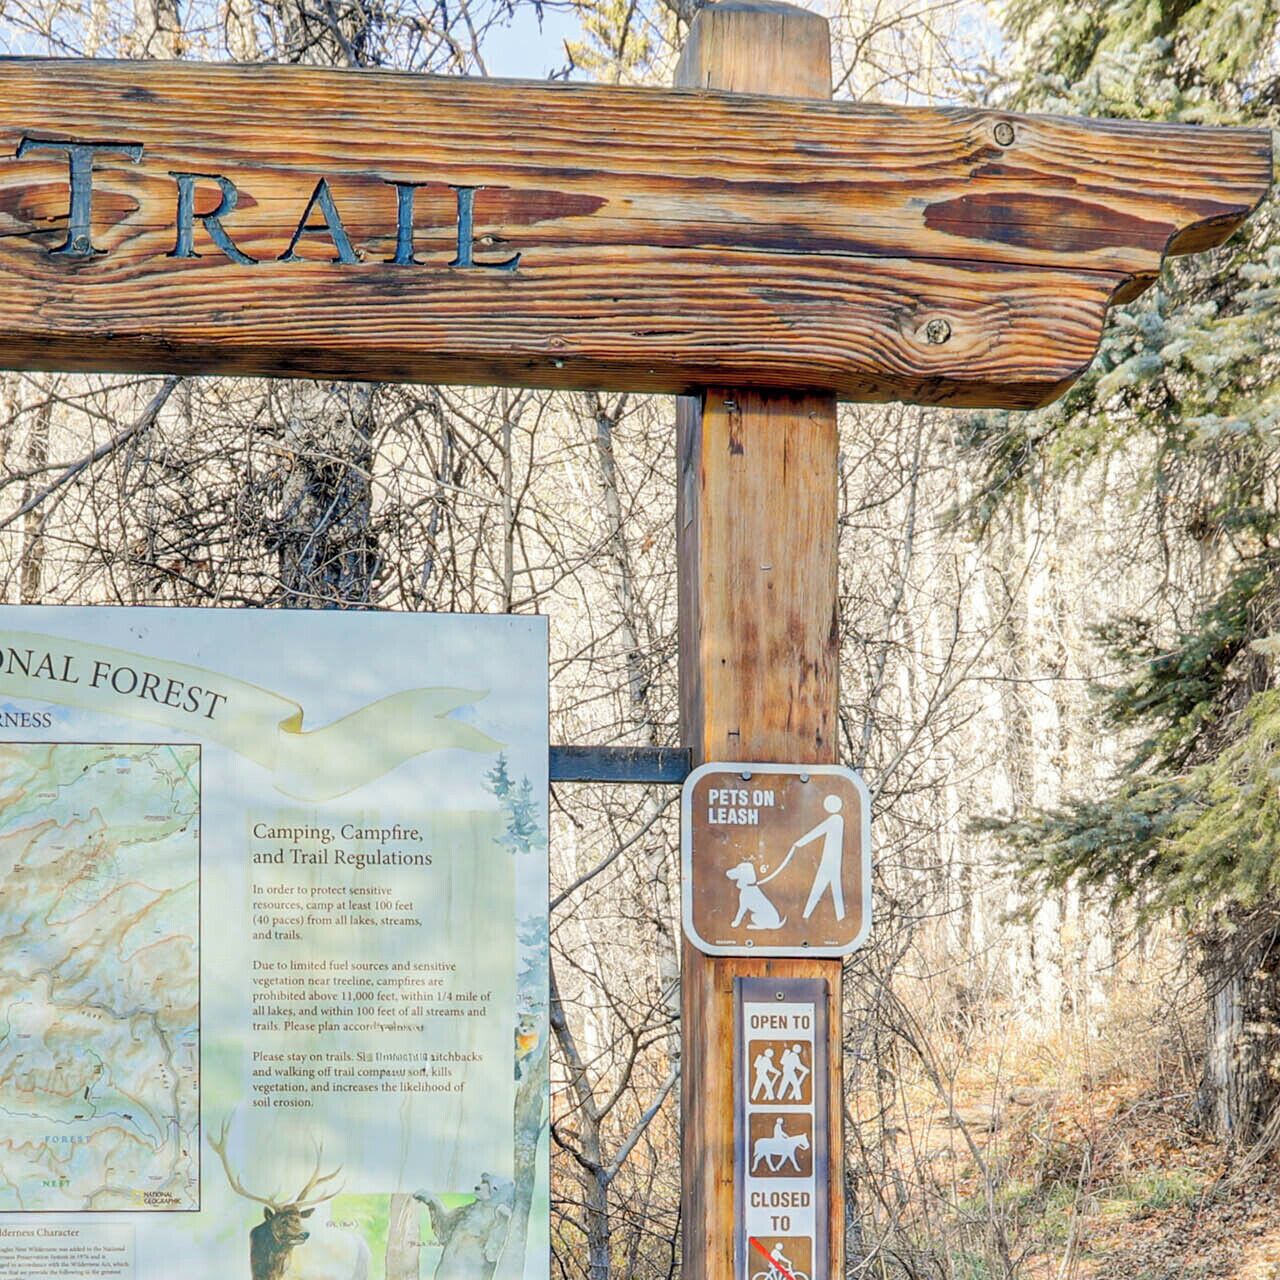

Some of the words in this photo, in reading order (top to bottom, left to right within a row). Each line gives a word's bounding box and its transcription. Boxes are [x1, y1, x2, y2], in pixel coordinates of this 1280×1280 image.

[15, 136, 523, 273] TRAIL
[87, 661, 229, 722] FOREST
[708, 788, 751, 806] PETS
[752, 789, 775, 807] ON
[708, 807, 759, 825] LEASH
[252, 822, 336, 845] Camping,
[340, 823, 424, 845] Campfire,
[252, 847, 285, 865] and
[288, 848, 329, 865] Trail
[334, 848, 433, 871] Regulations
[252, 883, 264, 895] In
[266, 883, 296, 896] order
[296, 885, 309, 896] to
[309, 886, 348, 899] protect
[348, 886, 393, 897] sensitive
[252, 901, 304, 914] resources,
[305, 902, 336, 914] camp
[336, 900, 347, 911] at
[348, 898, 372, 914] least
[374, 898, 393, 913] 100
[394, 899, 414, 912] feet
[252, 913, 270, 926] (40
[271, 914, 307, 929] paces)
[306, 913, 333, 926] from
[334, 914, 348, 926] all
[349, 914, 379, 927] lakes,
[379, 916, 423, 927] streams,
[252, 929, 274, 940] and
[274, 929, 304, 941] trails.
[750, 1014, 788, 1030] OPEN
[791, 1014, 811, 1031] TO
[750, 1191, 811, 1208] CLOSED
[770, 1215, 791, 1232] TO
[35, 1227, 80, 1238] Character
